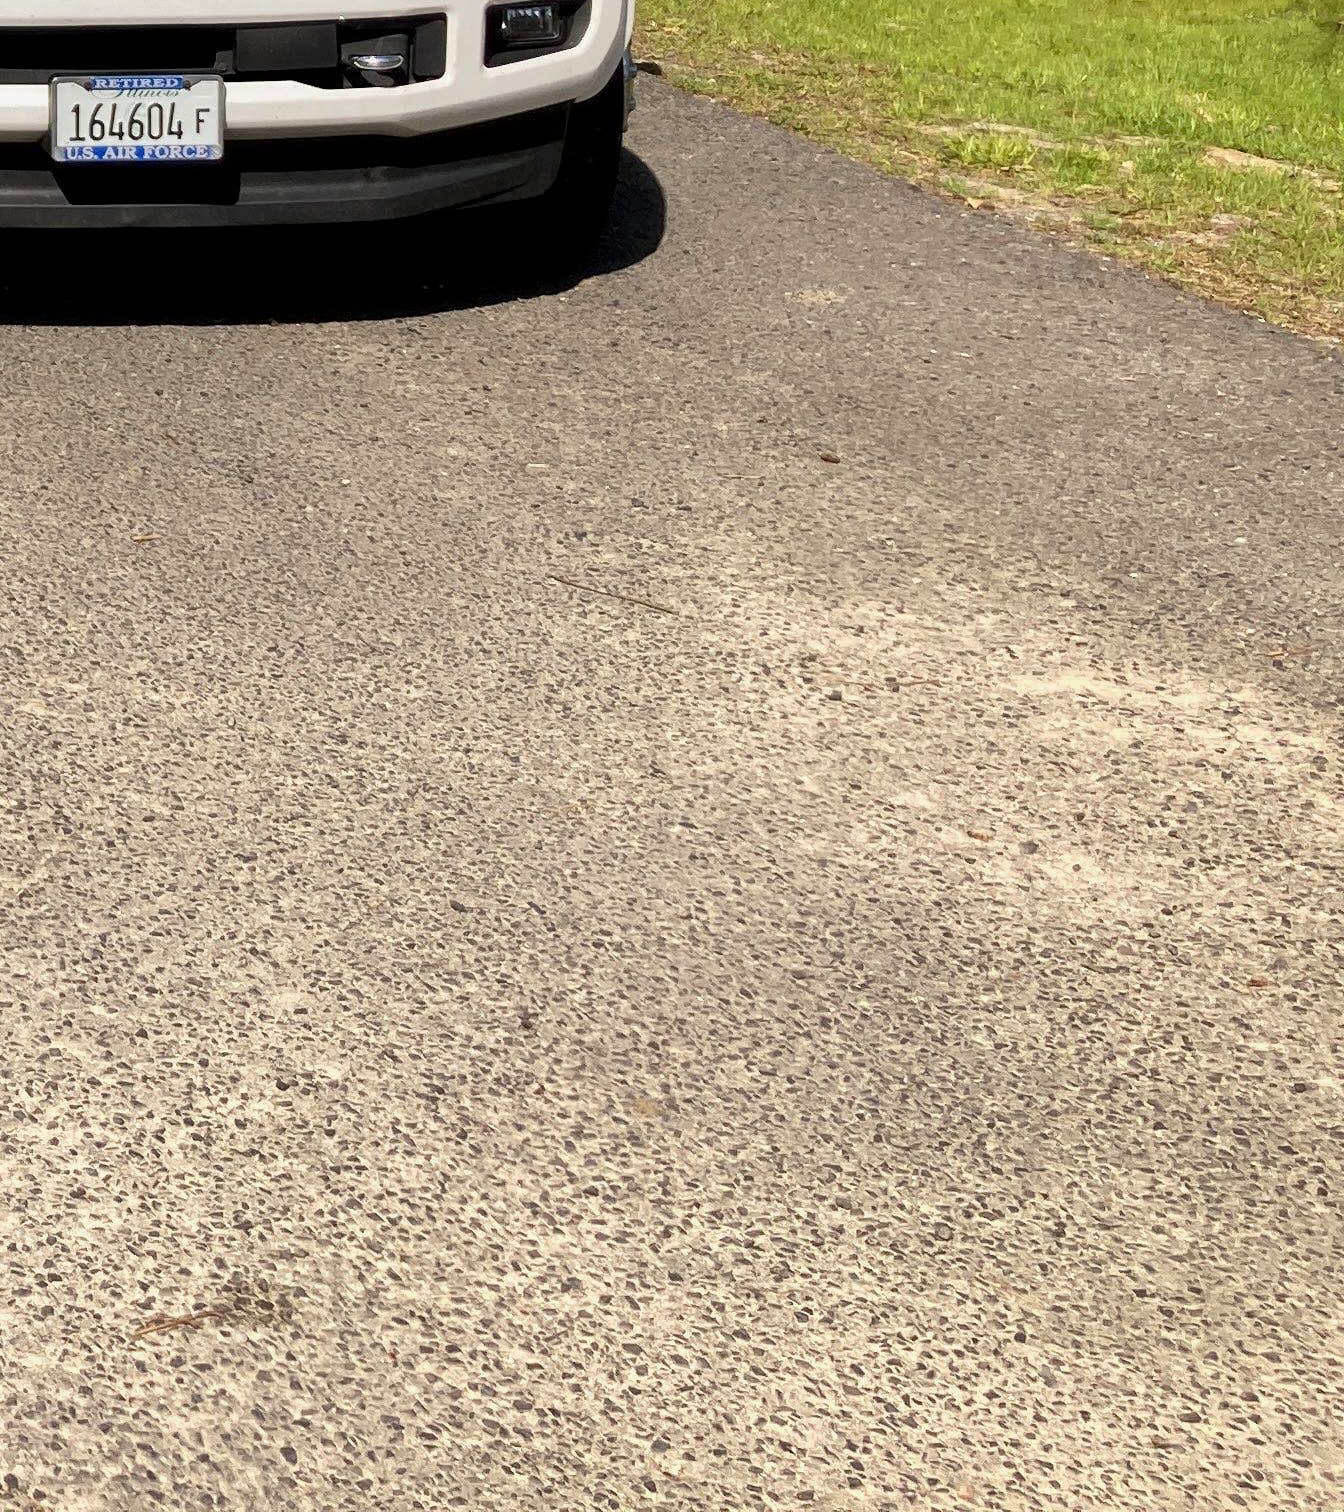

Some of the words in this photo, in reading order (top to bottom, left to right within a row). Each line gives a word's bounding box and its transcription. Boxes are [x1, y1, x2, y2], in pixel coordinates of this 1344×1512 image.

[94, 78, 180, 89] RETIRED
[69, 102, 183, 141] 164604
[195, 108, 210, 134] F
[66, 146, 98, 160] U.S.
[103, 146, 140, 160] AIR
[143, 145, 208, 160] FORCE
